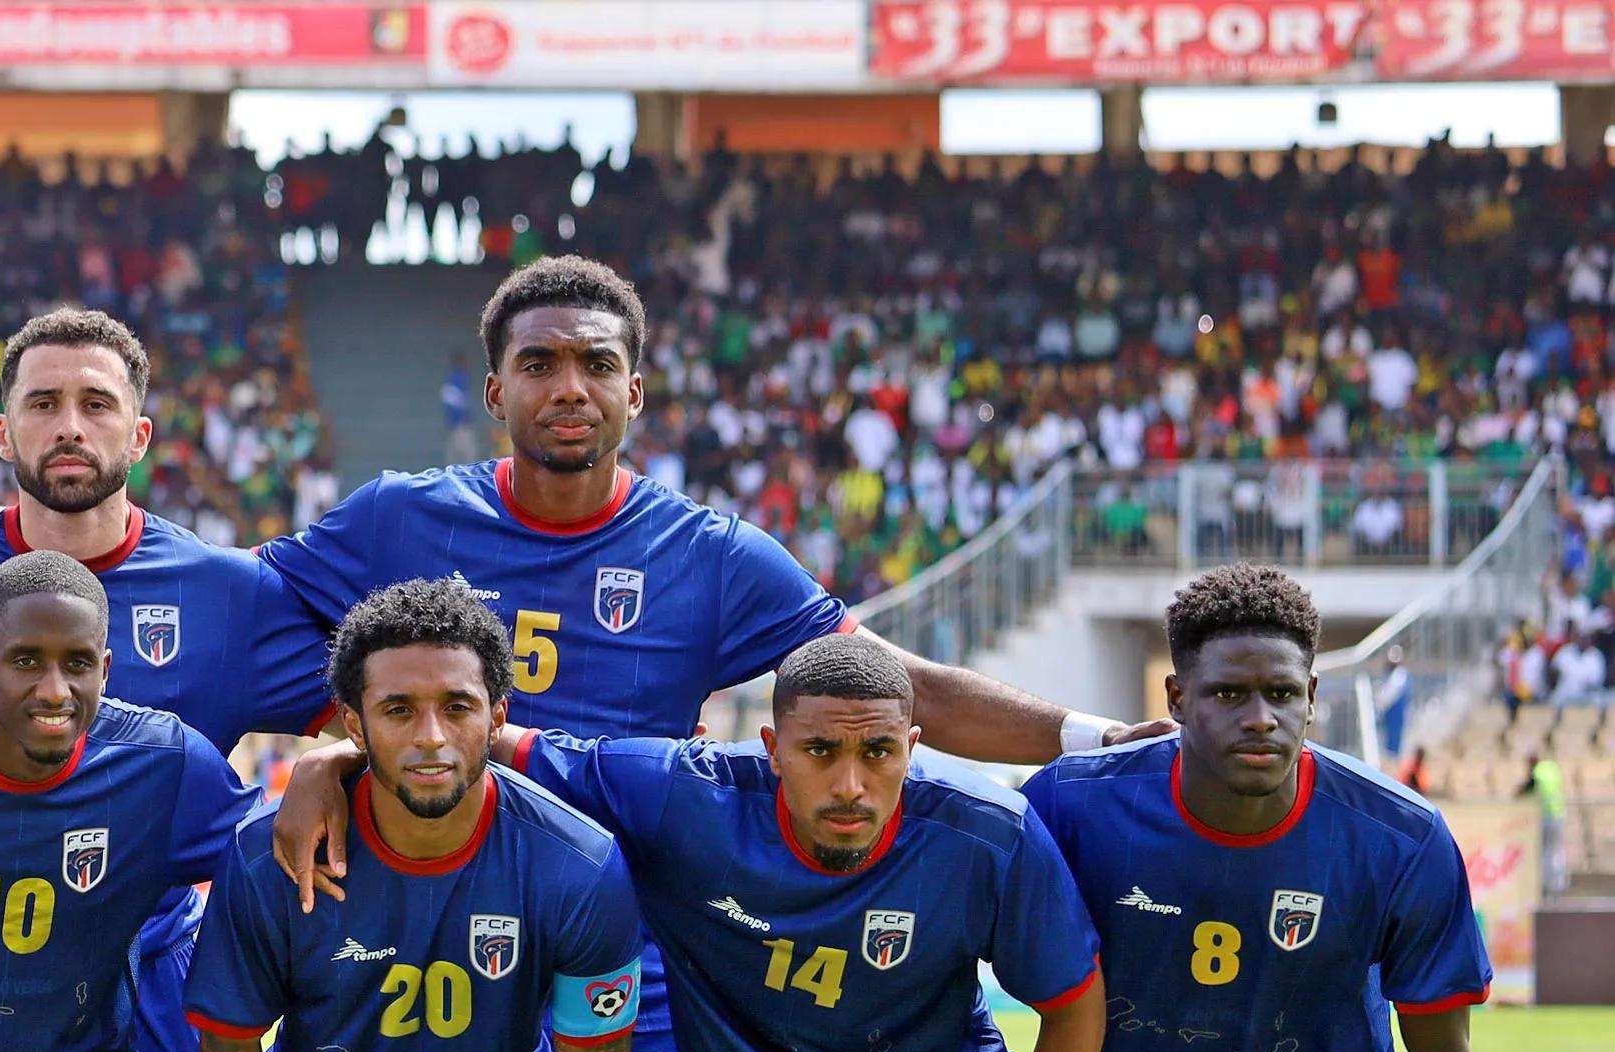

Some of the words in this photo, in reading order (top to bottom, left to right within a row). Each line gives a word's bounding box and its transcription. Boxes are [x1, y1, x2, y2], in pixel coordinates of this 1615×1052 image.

[1046, 3, 1363, 59] EXPORT
[600, 571, 640, 583] FCF
[470, 587, 501, 601] mpo
[136, 608, 175, 618] FCF
[512, 609, 561, 694] 5
[67, 832, 105, 846] FCF
[1277, 893, 1319, 906] FCF
[1138, 902, 1182, 915] tempo
[474, 918, 516, 930] FCF
[727, 909, 771, 932] tempo
[869, 914, 910, 925] FCF
[353, 946, 397, 962] tempo
[1191, 920, 1242, 986] 8
[762, 938, 848, 1009] 14
[380, 960, 472, 1039] 20
